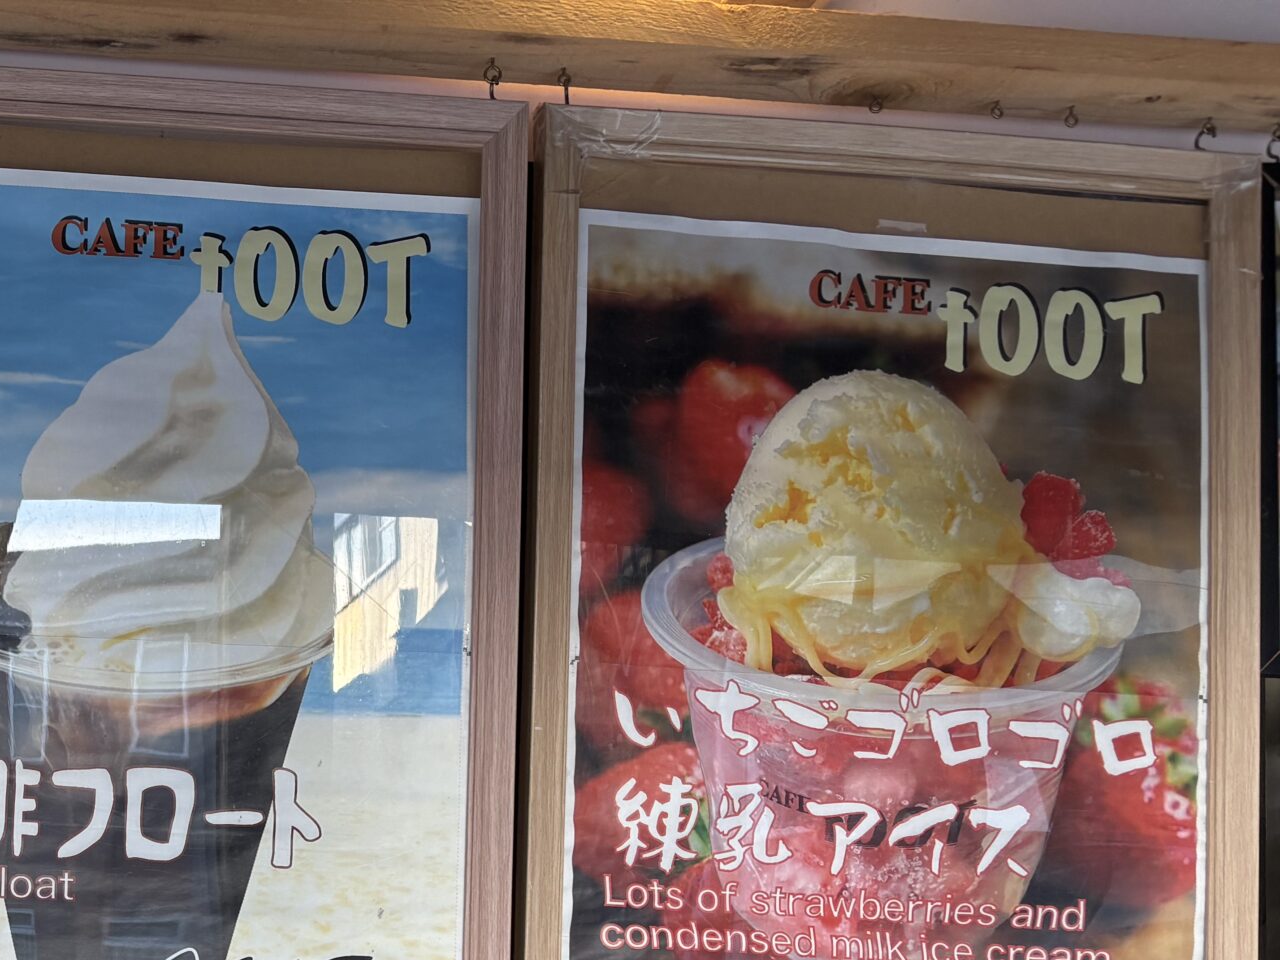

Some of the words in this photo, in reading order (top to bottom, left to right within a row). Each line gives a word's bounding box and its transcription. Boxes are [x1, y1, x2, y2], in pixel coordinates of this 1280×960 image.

[51, 215, 185, 260] CAFE
[808, 268, 932, 316] CAFE
[614, 680, 1158, 777] いちごゴロゴロ
[602, 874, 683, 911] Lots
[696, 880, 738, 914] of
[750, 887, 997, 926] strawberries
[1011, 898, 1087, 933] and
[599, 921, 817, 959] condensed
